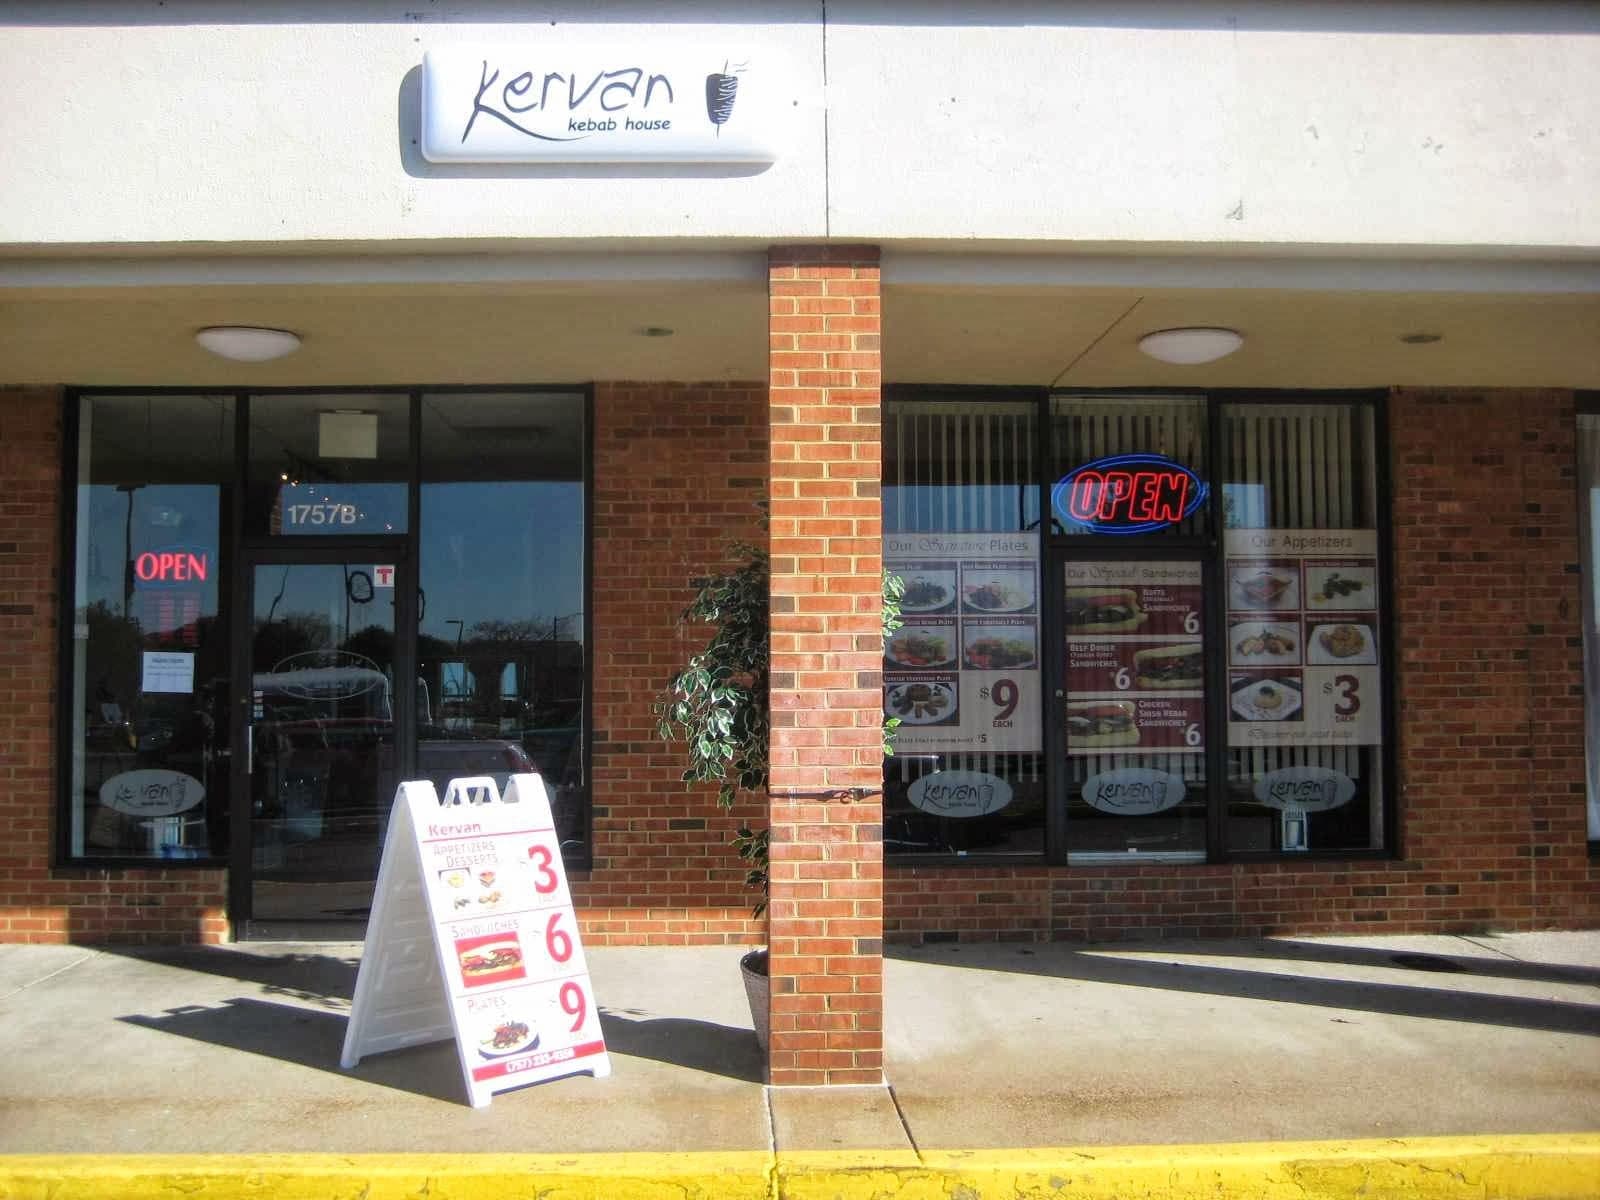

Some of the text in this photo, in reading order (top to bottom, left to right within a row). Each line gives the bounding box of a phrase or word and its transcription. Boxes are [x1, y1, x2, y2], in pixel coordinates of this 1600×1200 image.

[461, 60, 674, 143] Kervan
[568, 117, 671, 132] kebab house
[1069, 470, 1189, 523] OPEN
[287, 504, 357, 525] 1757B
[888, 539, 912, 551] Our
[990, 538, 1029, 552] Plates
[1251, 535, 1353, 550] Our Appetizers
[135, 552, 207, 582] OPEN
[1142, 568, 1200, 579] Sandwiches
[428, 823, 481, 837] Kervan
[446, 853, 499, 868] DESSERTS
